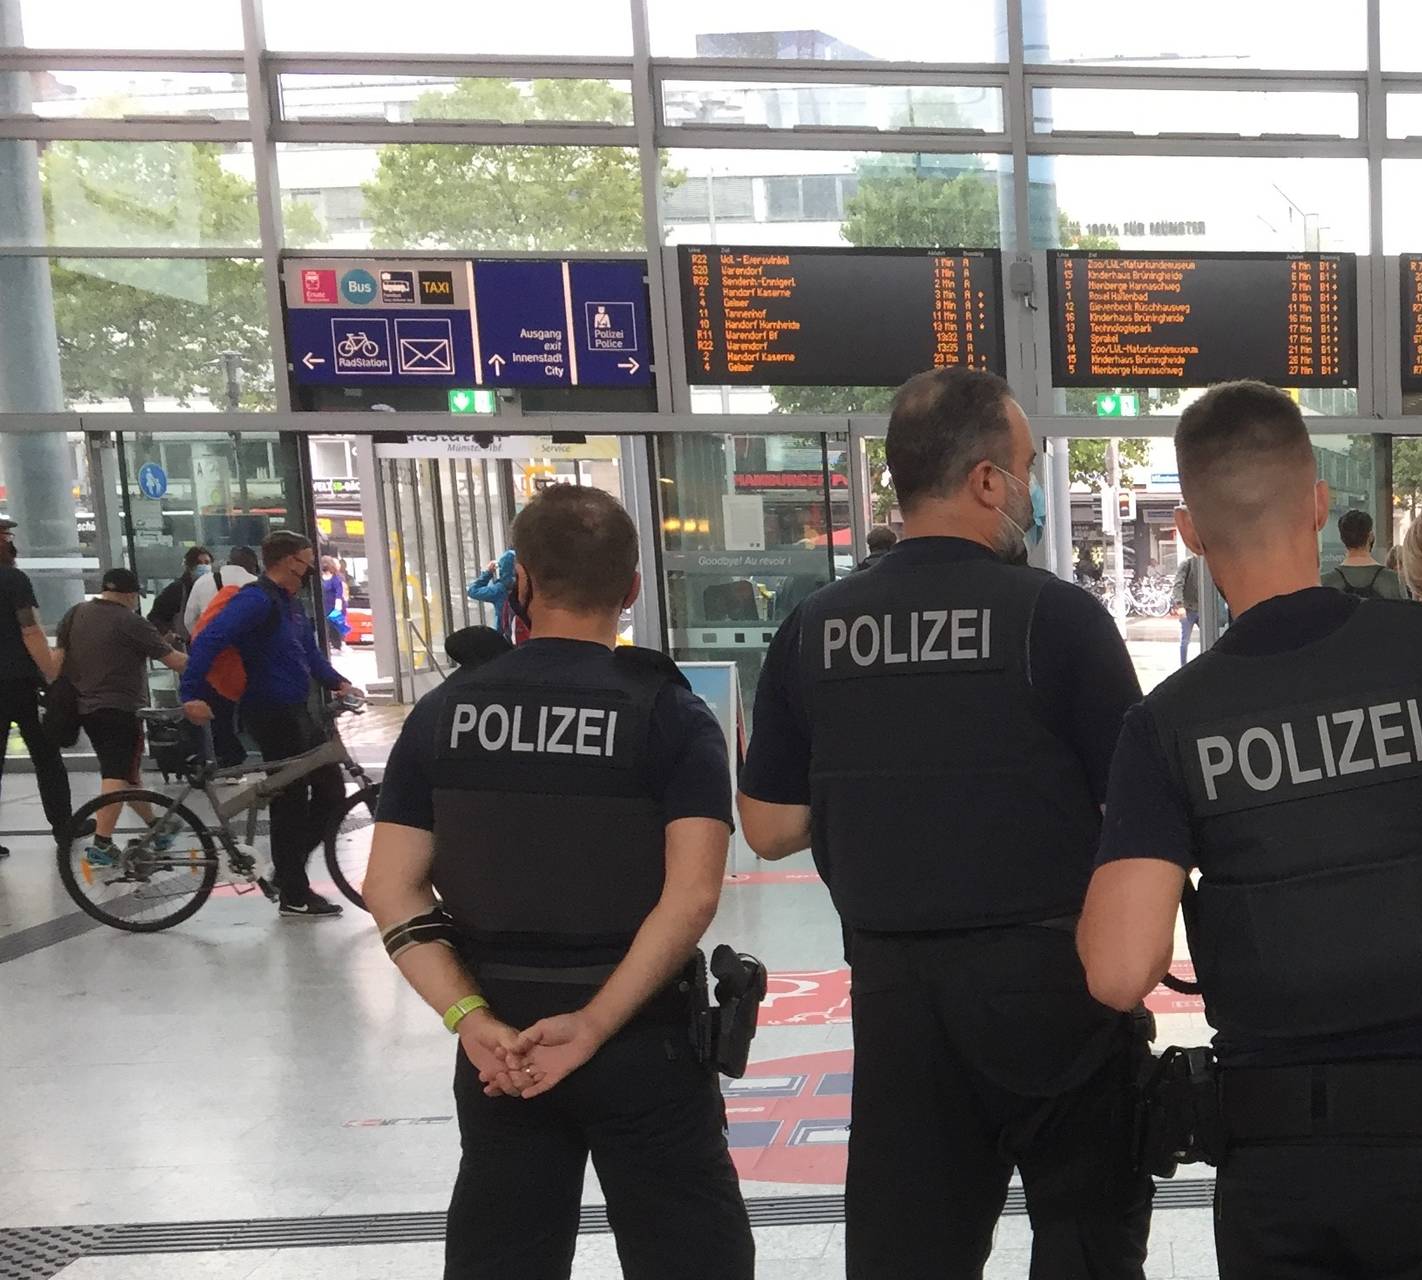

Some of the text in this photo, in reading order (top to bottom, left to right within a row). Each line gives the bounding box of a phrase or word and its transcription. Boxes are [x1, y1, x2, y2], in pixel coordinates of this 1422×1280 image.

[349, 281, 372, 293] Bus
[422, 281, 450, 294] TAXI
[520, 328, 562, 341] Ausgang
[594, 329, 624, 339] Polizei
[544, 341, 562, 351] exit
[595, 338, 623, 348] Police
[338, 357, 388, 368] RadStation
[512, 352, 563, 363] Innenstadt
[544, 365, 564, 378] City
[698, 555, 743, 568] Goodbye!
[743, 556, 758, 566] Au
[822, 608, 991, 670] POLIZEI
[449, 703, 618, 757] POLIZEI
